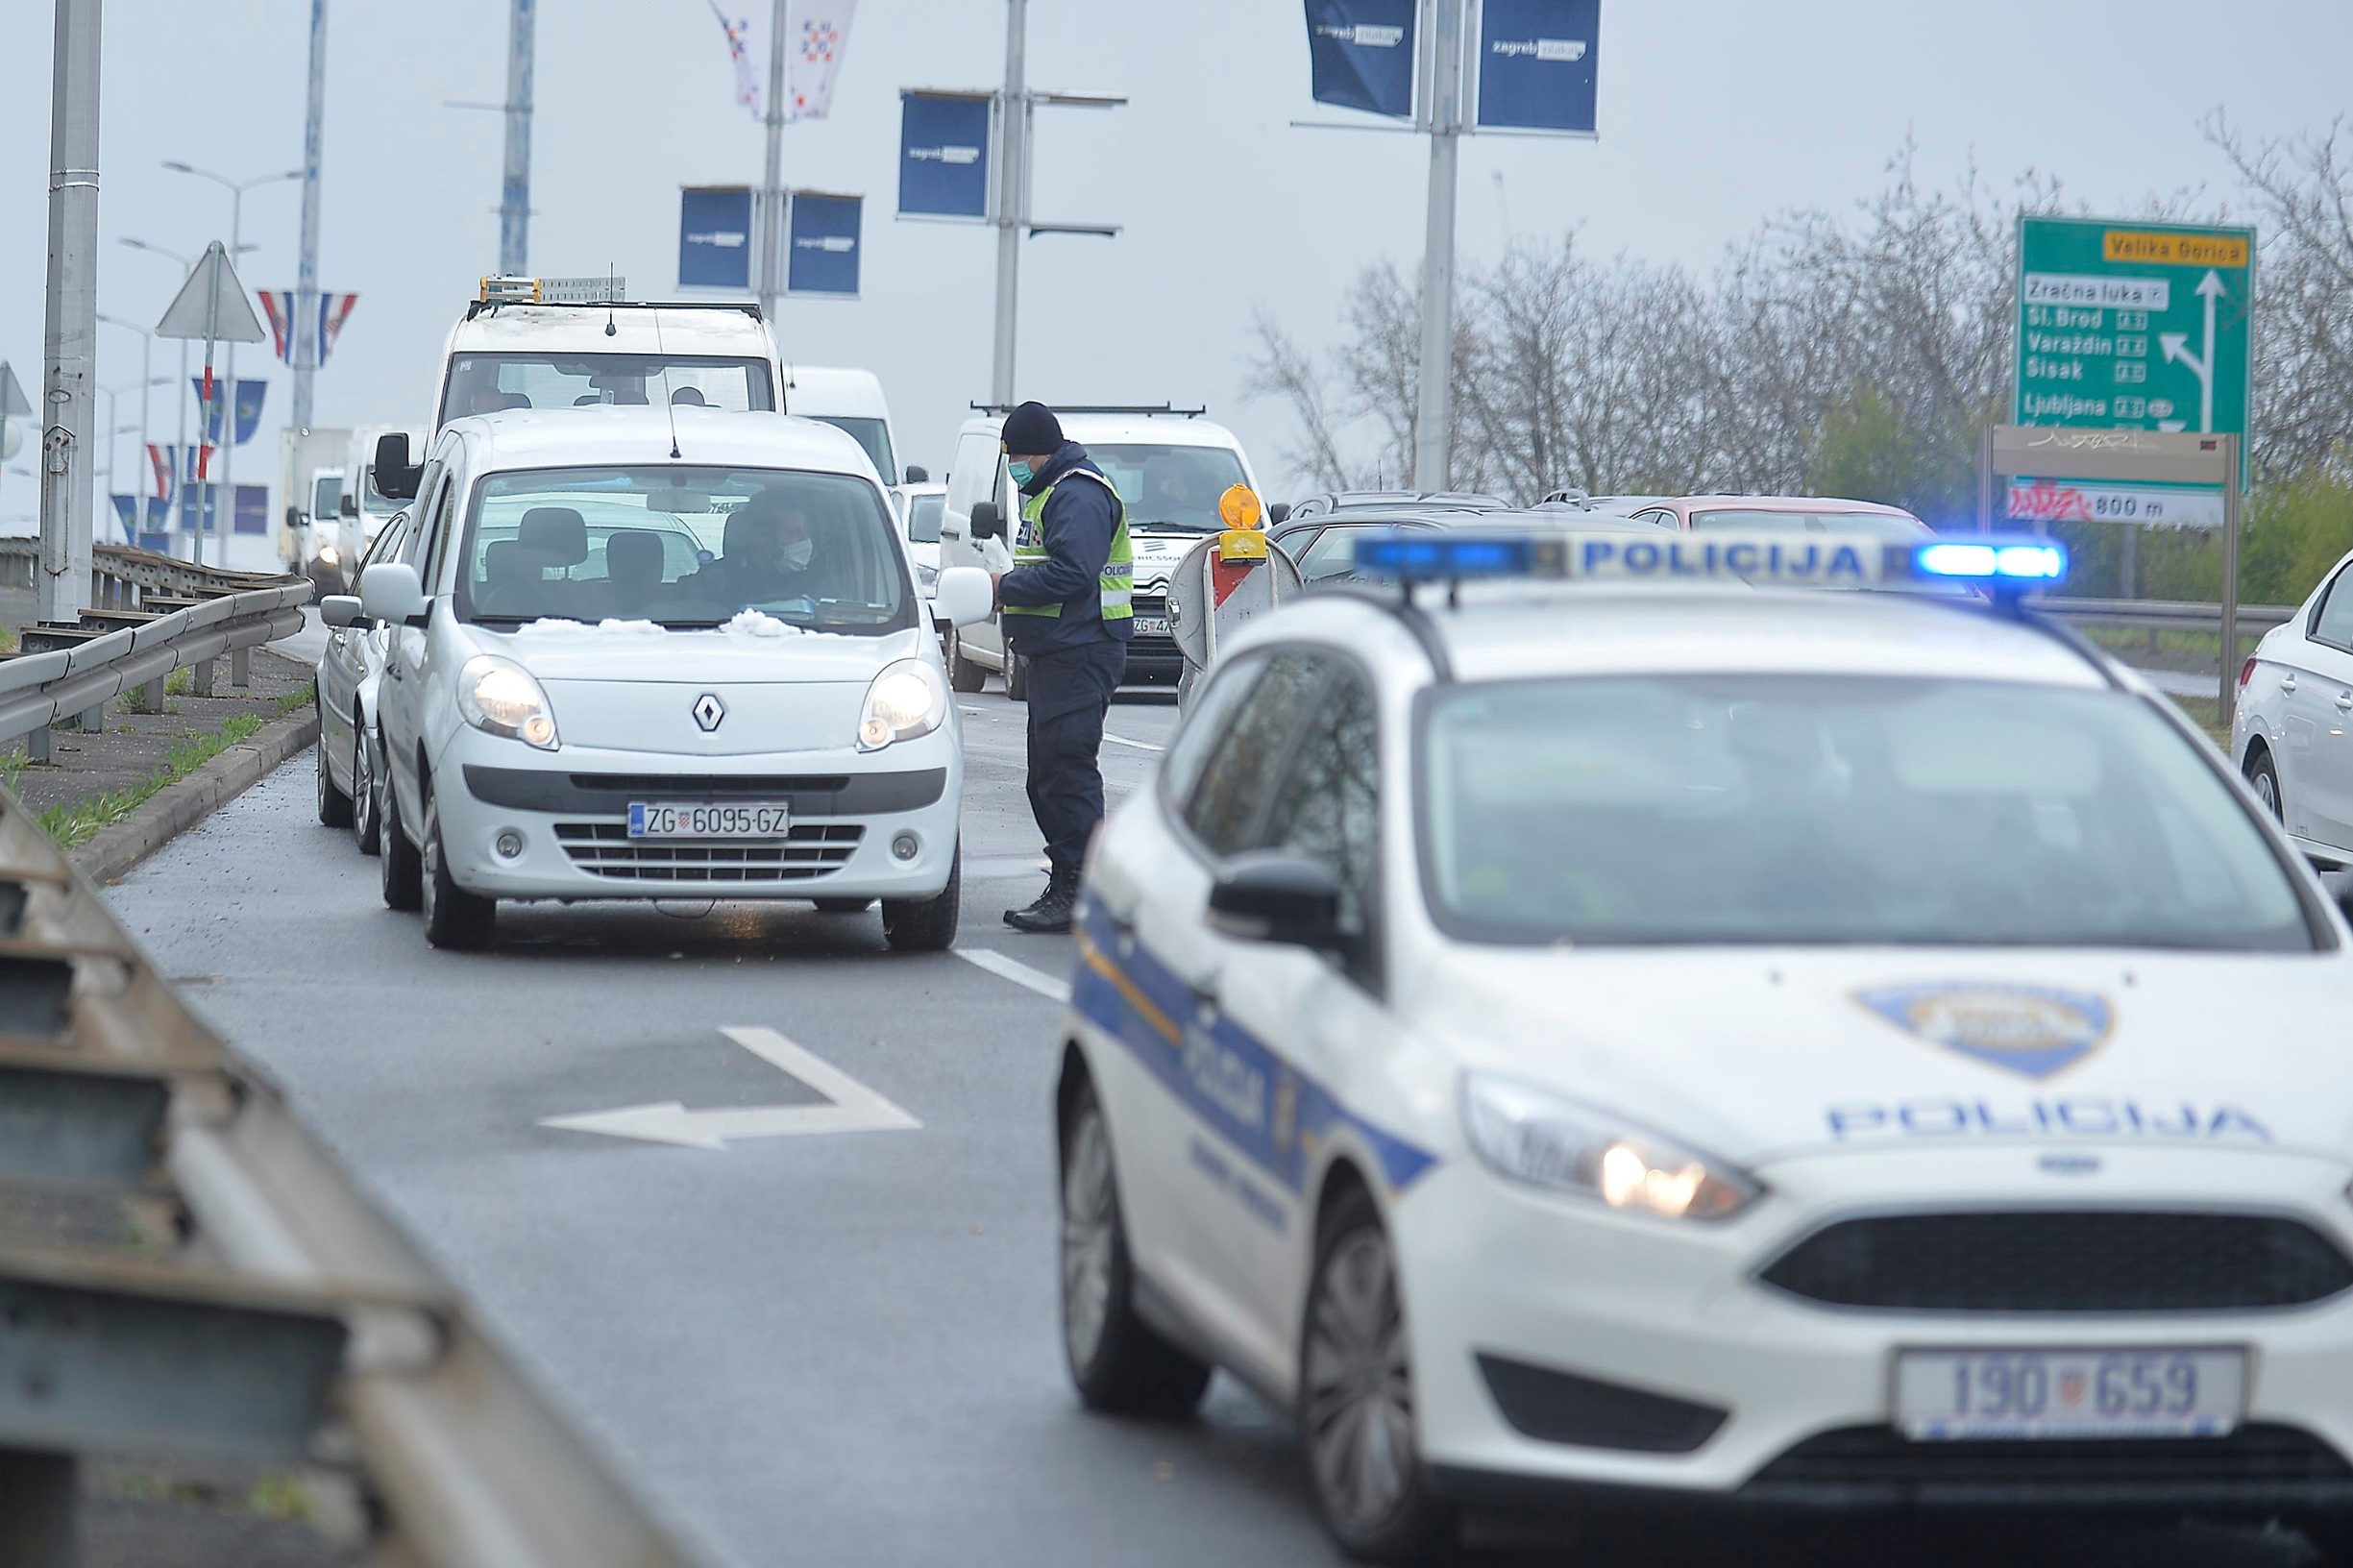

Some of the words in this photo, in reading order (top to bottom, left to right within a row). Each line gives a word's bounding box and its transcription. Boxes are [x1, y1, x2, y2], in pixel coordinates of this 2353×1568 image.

[2112, 237, 2169, 257] Velika
[2178, 240, 2242, 262] Gorica
[2028, 280, 2096, 302] Zračna
[2102, 284, 2142, 304] luka
[2056, 307, 2103, 330] Brod
[2027, 331, 2113, 356] Varaždin
[2026, 355, 2083, 380] Sisak
[2023, 393, 2107, 419] Ljubljana
[2096, 496, 2137, 517] 800
[2145, 502, 2163, 518] m
[1581, 541, 1863, 575] POLICIJA
[1134, 620, 1148, 631] ZG
[647, 808, 675, 833] ZG
[1826, 1100, 2274, 1142] POLICIJA
[1953, 1352, 2048, 1417] 190
[2096, 1351, 2198, 1417] 659
